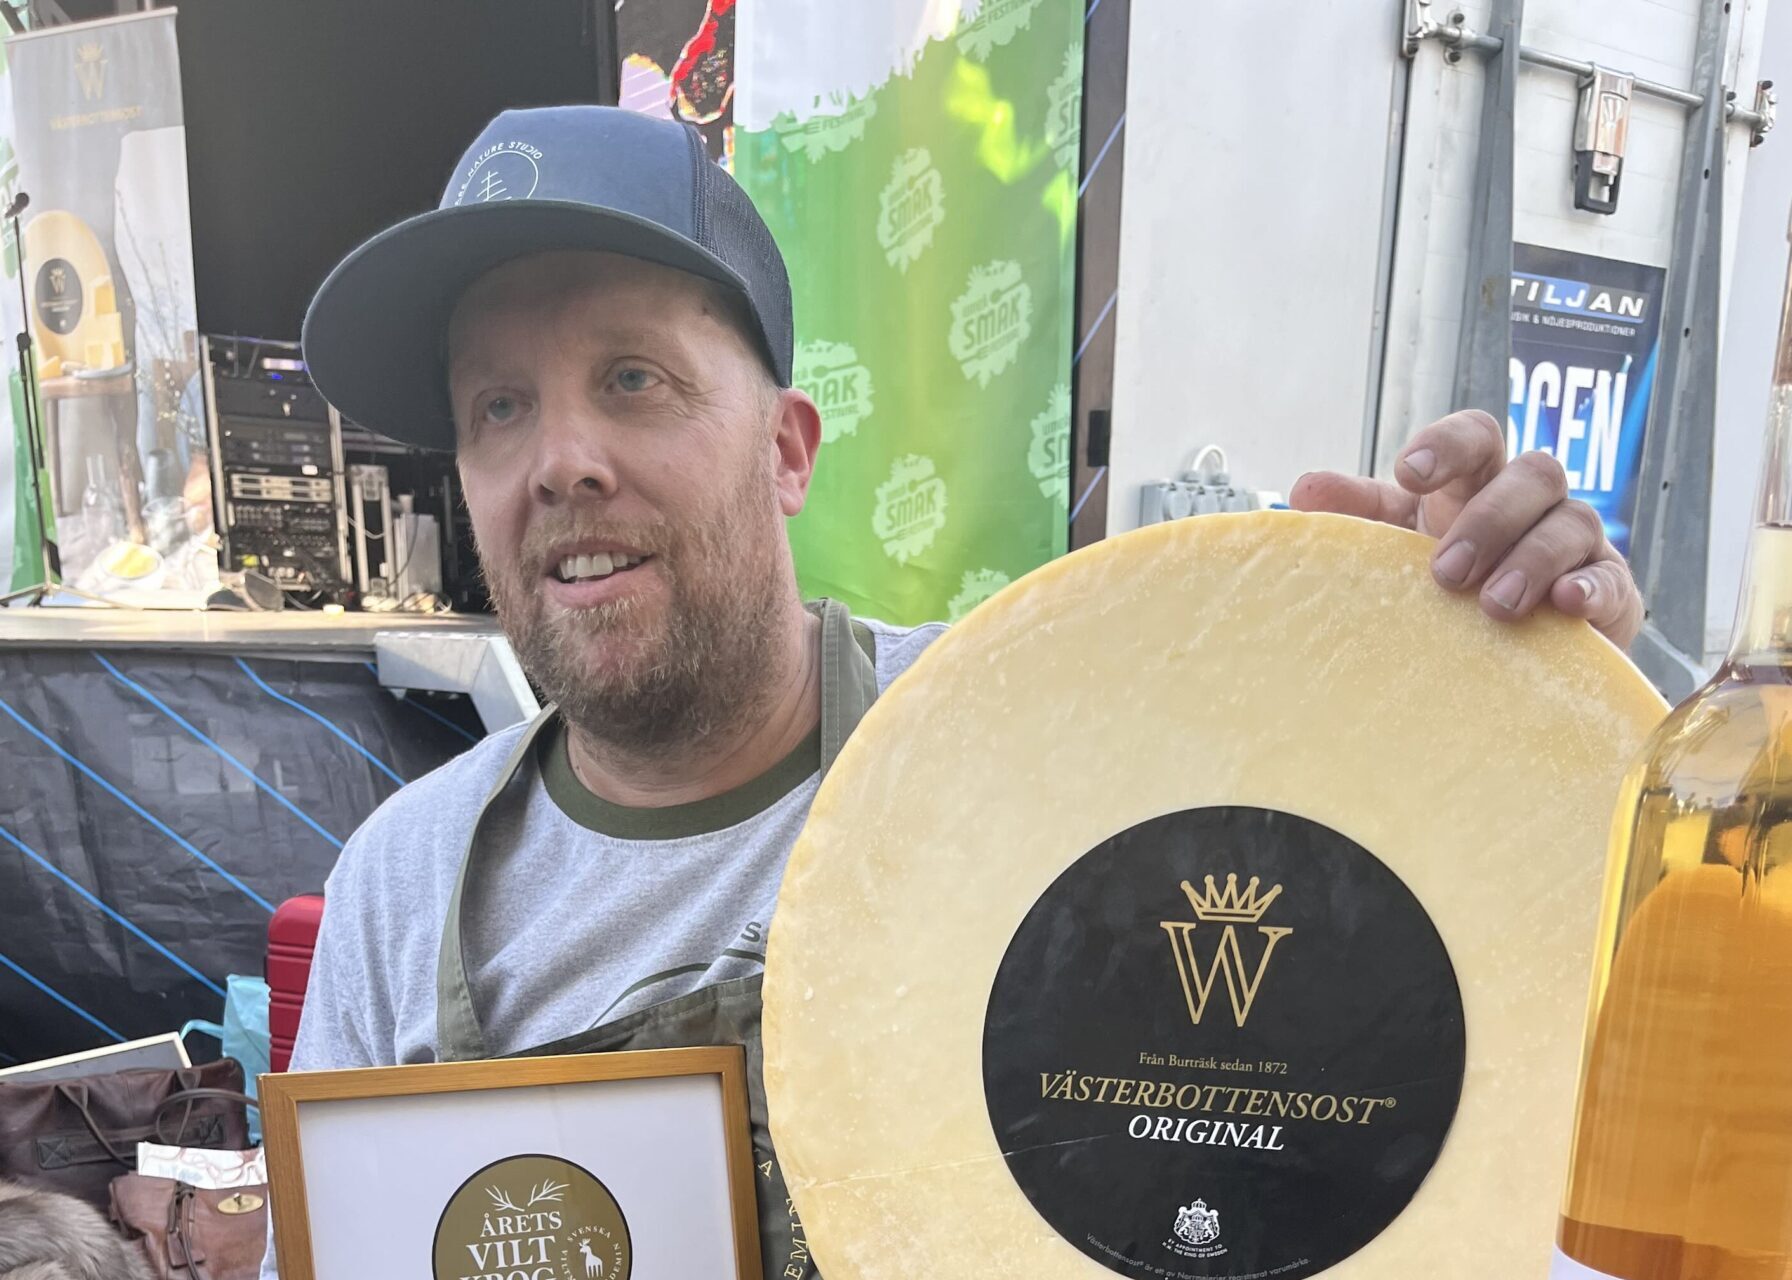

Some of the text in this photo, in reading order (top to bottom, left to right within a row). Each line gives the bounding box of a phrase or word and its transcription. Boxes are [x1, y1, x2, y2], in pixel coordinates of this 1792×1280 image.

[467, 142, 505, 178] NATURE
[508, 141, 543, 160] STUDIO
[963, 291, 1021, 351] SMAK
[886, 484, 937, 532] SMAK
[1139, 1051, 1288, 1075] Från Burträsk sedan 1872
[1127, 1114, 1286, 1152] ORIGINAL
[480, 1211, 562, 1238] ÅRETS
[567, 1225, 611, 1242] SVENSKA
[466, 1235, 556, 1271] VILT
[1206, 1247, 1229, 1258] SWEDEN
[1214, 1243, 1223, 1251] TO
[1144, 1263, 1154, 1272] är
[1166, 1270, 1175, 1278] av
